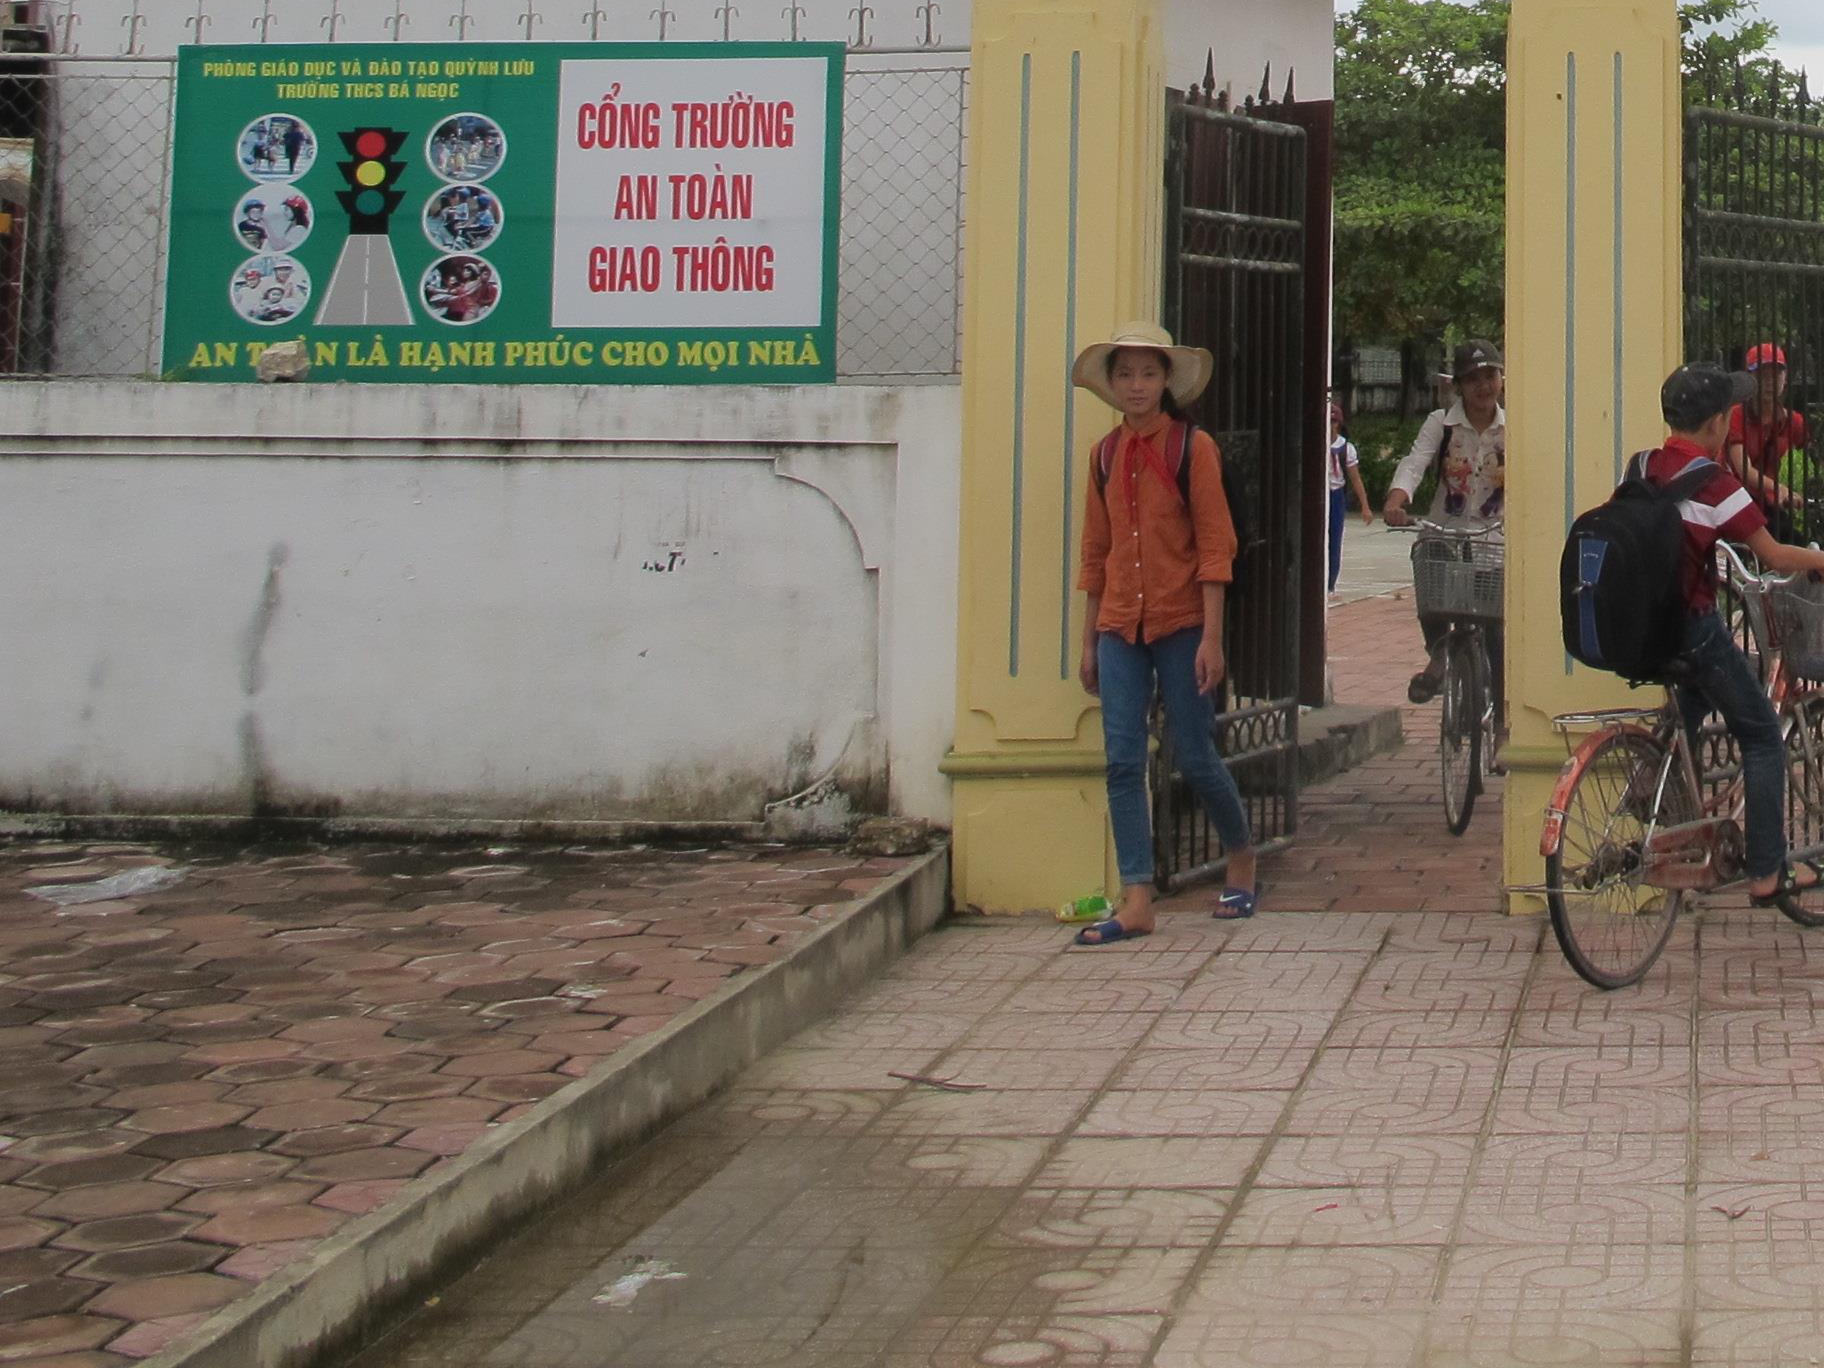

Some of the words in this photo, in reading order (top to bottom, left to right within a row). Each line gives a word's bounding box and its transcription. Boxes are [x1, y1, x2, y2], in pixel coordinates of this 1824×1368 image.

[203, 59, 257, 77] PHÒNG
[260, 58, 299, 76] GIÁO
[303, 61, 336, 80] DỤC
[341, 58, 362, 76] VÀ
[368, 57, 402, 76] ĐÀO
[407, 60, 439, 79] TẠO
[445, 57, 499, 78] QUỲNH
[504, 57, 535, 76] LƯU
[277, 76, 339, 99] TRƯỜNG
[346, 82, 384, 99] THCS
[388, 80, 410, 98] BÁ
[415, 83, 460, 102] NGỌC
[577, 82, 661, 149] CỔNG
[671, 90, 795, 149] TRƯỜNG
[613, 174, 659, 221] AN
[668, 163, 753, 221] TOÀN
[588, 246, 662, 293] GIAO
[671, 236, 775, 293] THÔNG
[188, 343, 238, 368] AN
[245, 335, 339, 367] TN
[346, 334, 390, 367] LÀ
[398, 341, 496, 374] HẠNH
[503, 334, 594, 366] PHÚC
[600, 341, 670, 366] CHO
[677, 341, 740, 373] MỌI
[747, 333, 821, 366] NHÀ
